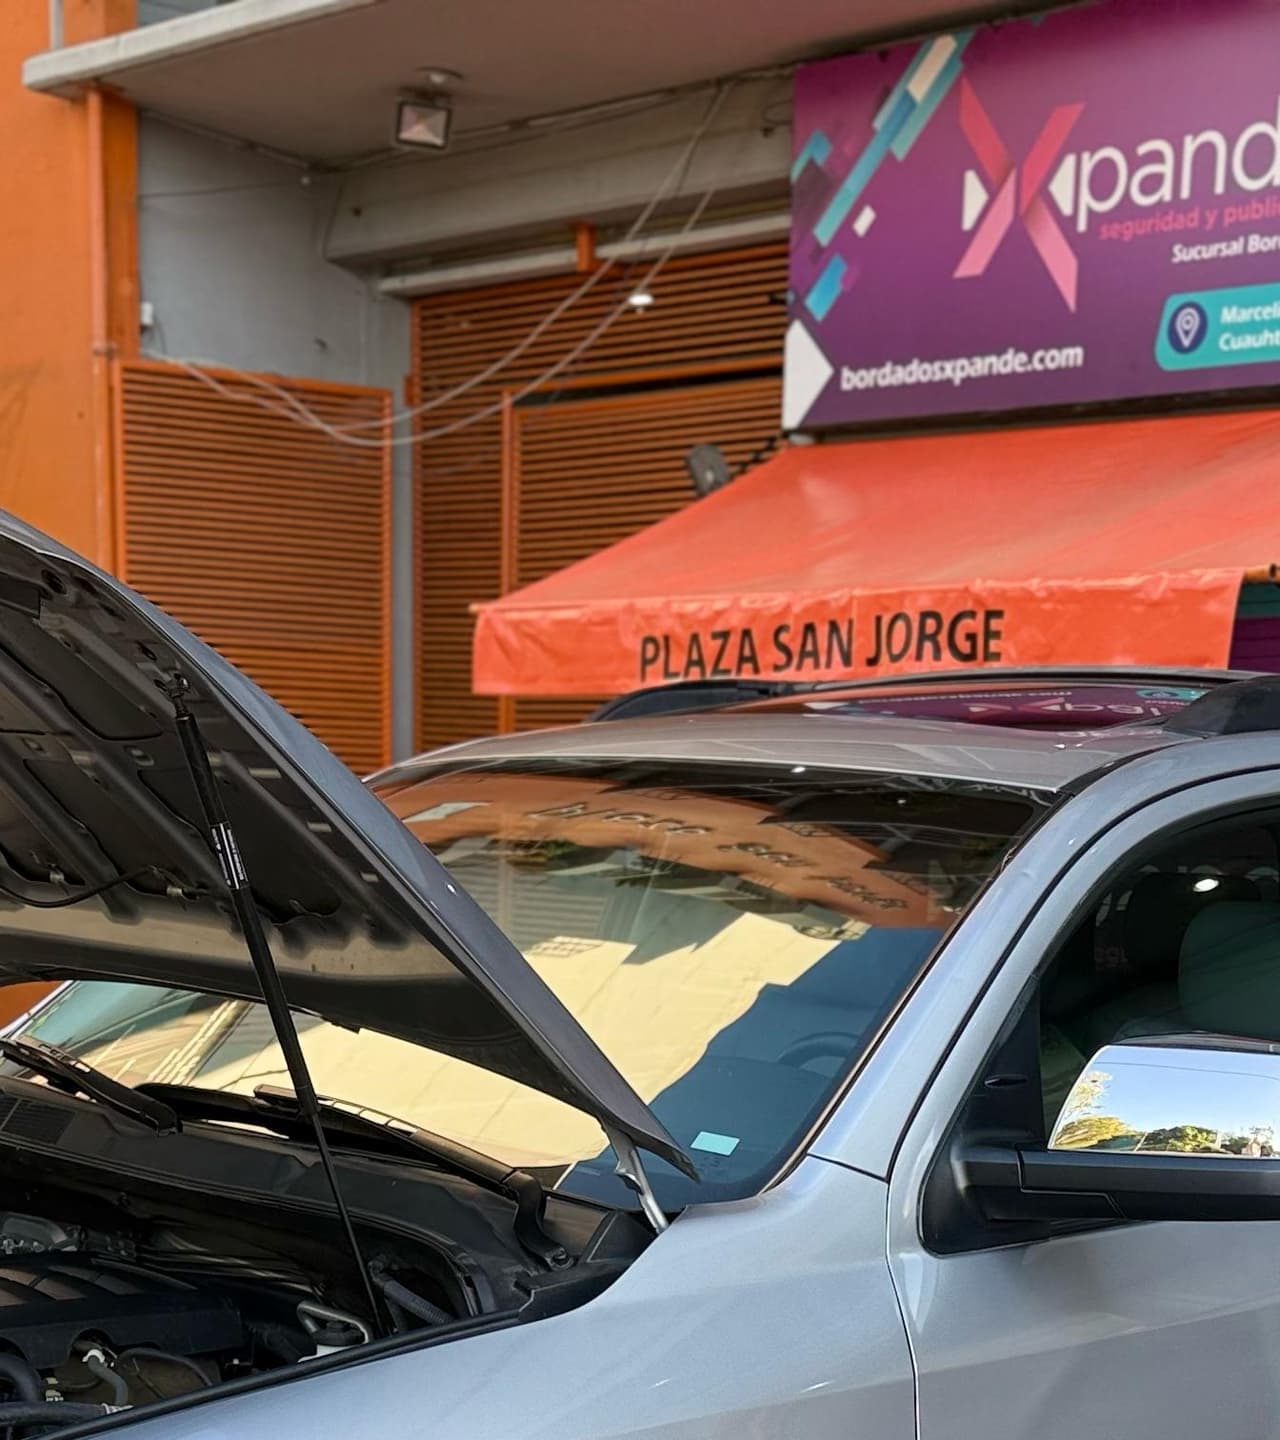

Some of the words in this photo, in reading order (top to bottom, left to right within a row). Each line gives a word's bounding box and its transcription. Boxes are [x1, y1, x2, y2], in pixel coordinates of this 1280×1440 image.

[1100, 207, 1199, 241] seguridad
[1204, 208, 1219, 229] y
[1171, 236, 1244, 263] Sucursal
[840, 346, 1084, 391] bordadosxpande.com
[640, 626, 761, 683] PLAZA
[772, 617, 854, 674] SAN
[866, 609, 1005, 667] JORGE
